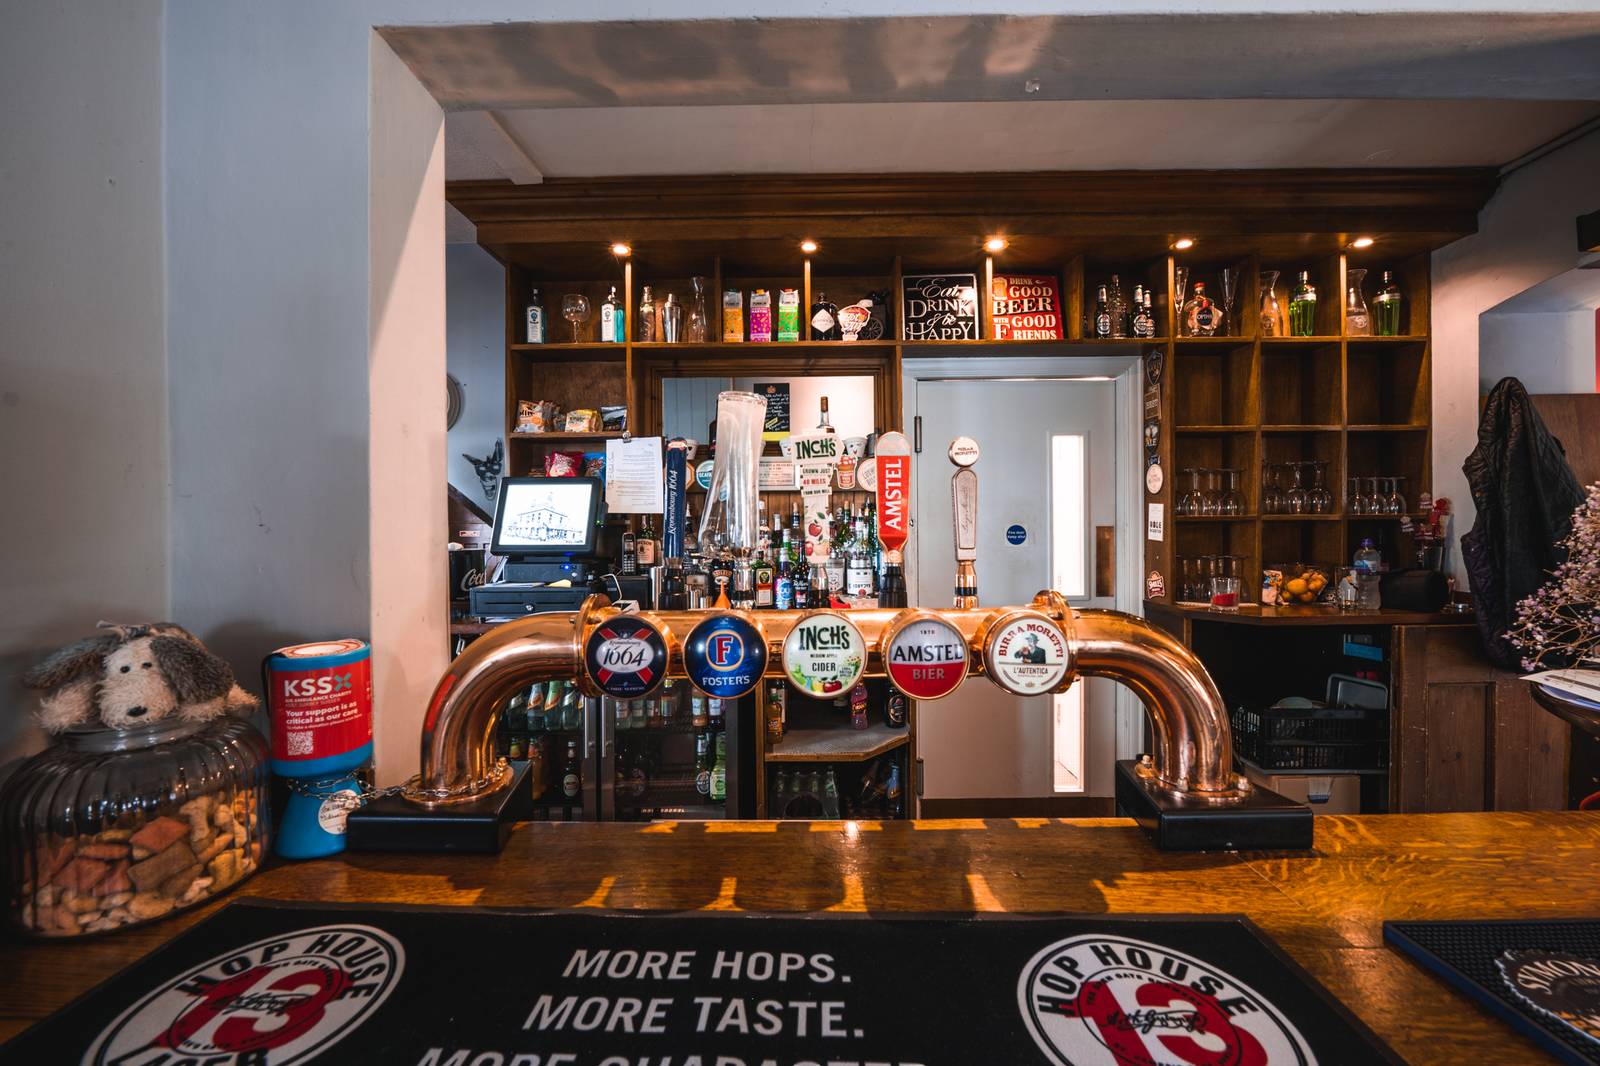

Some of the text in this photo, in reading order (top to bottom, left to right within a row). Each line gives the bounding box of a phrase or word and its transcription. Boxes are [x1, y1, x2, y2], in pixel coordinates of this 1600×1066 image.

[1009, 286, 1053, 298] GOOD
[909, 299, 974, 318] DRINK
[992, 297, 1053, 316] BEER
[906, 321, 974, 340] HAPPY
[1011, 314, 1057, 328] GOOD
[795, 438, 837, 460] INCH'S
[669, 470, 678, 490] 1664
[885, 458, 902, 531] AMSTEL
[799, 625, 850, 650] INCH'S
[999, 624, 1064, 657] BIRRA MORETTI
[603, 645, 648, 667] 1664
[715, 636, 733, 664] F
[893, 644, 963, 661] AMSTEL
[812, 662, 836, 671] CIDER
[912, 668, 944, 680] BIER
[284, 676, 333, 697] KSS
[702, 675, 750, 686] FOSTER'S
[286, 716, 313, 724] critical
[342, 708, 359, 717] care
[305, 705, 340, 717] support
[176, 943, 291, 995] HOP
[302, 934, 387, 1000] HOUSE
[562, 949, 852, 983] MORE HOPS.
[1037, 956, 1084, 1017] HOP
[1089, 944, 1259, 1018] HOUSE
[522, 995, 864, 1038] MORE TASTE.
